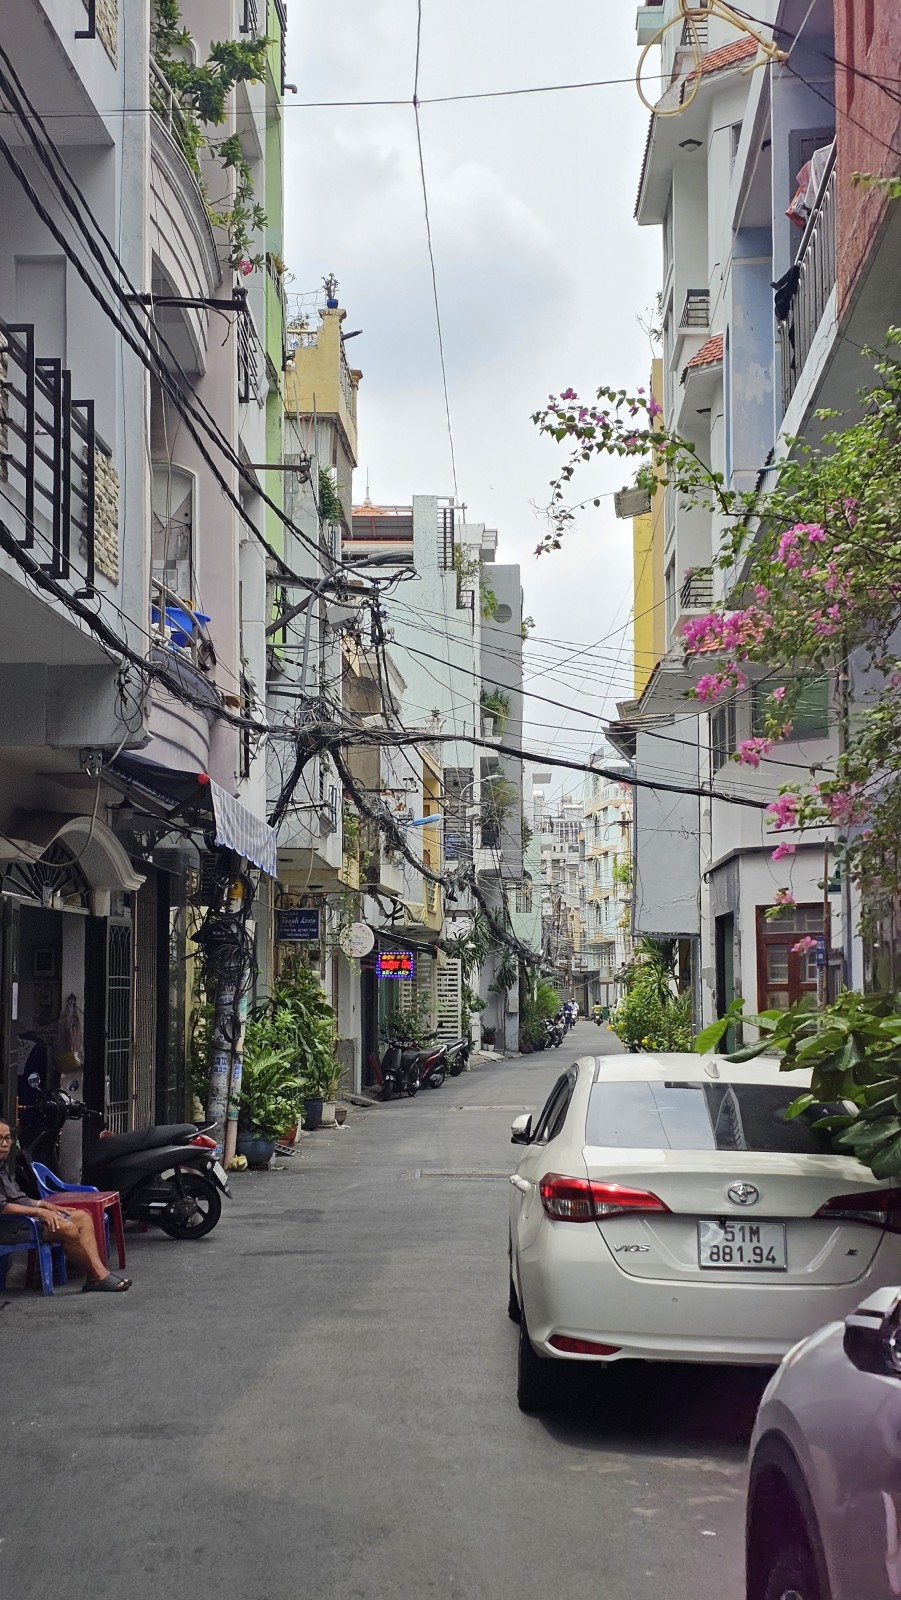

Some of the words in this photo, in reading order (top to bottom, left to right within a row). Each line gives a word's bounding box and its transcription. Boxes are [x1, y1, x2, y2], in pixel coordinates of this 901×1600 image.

[724, 1225, 761, 1243] 51M
[613, 1243, 651, 1253] VIOS
[709, 1244, 777, 1264] 881.94
